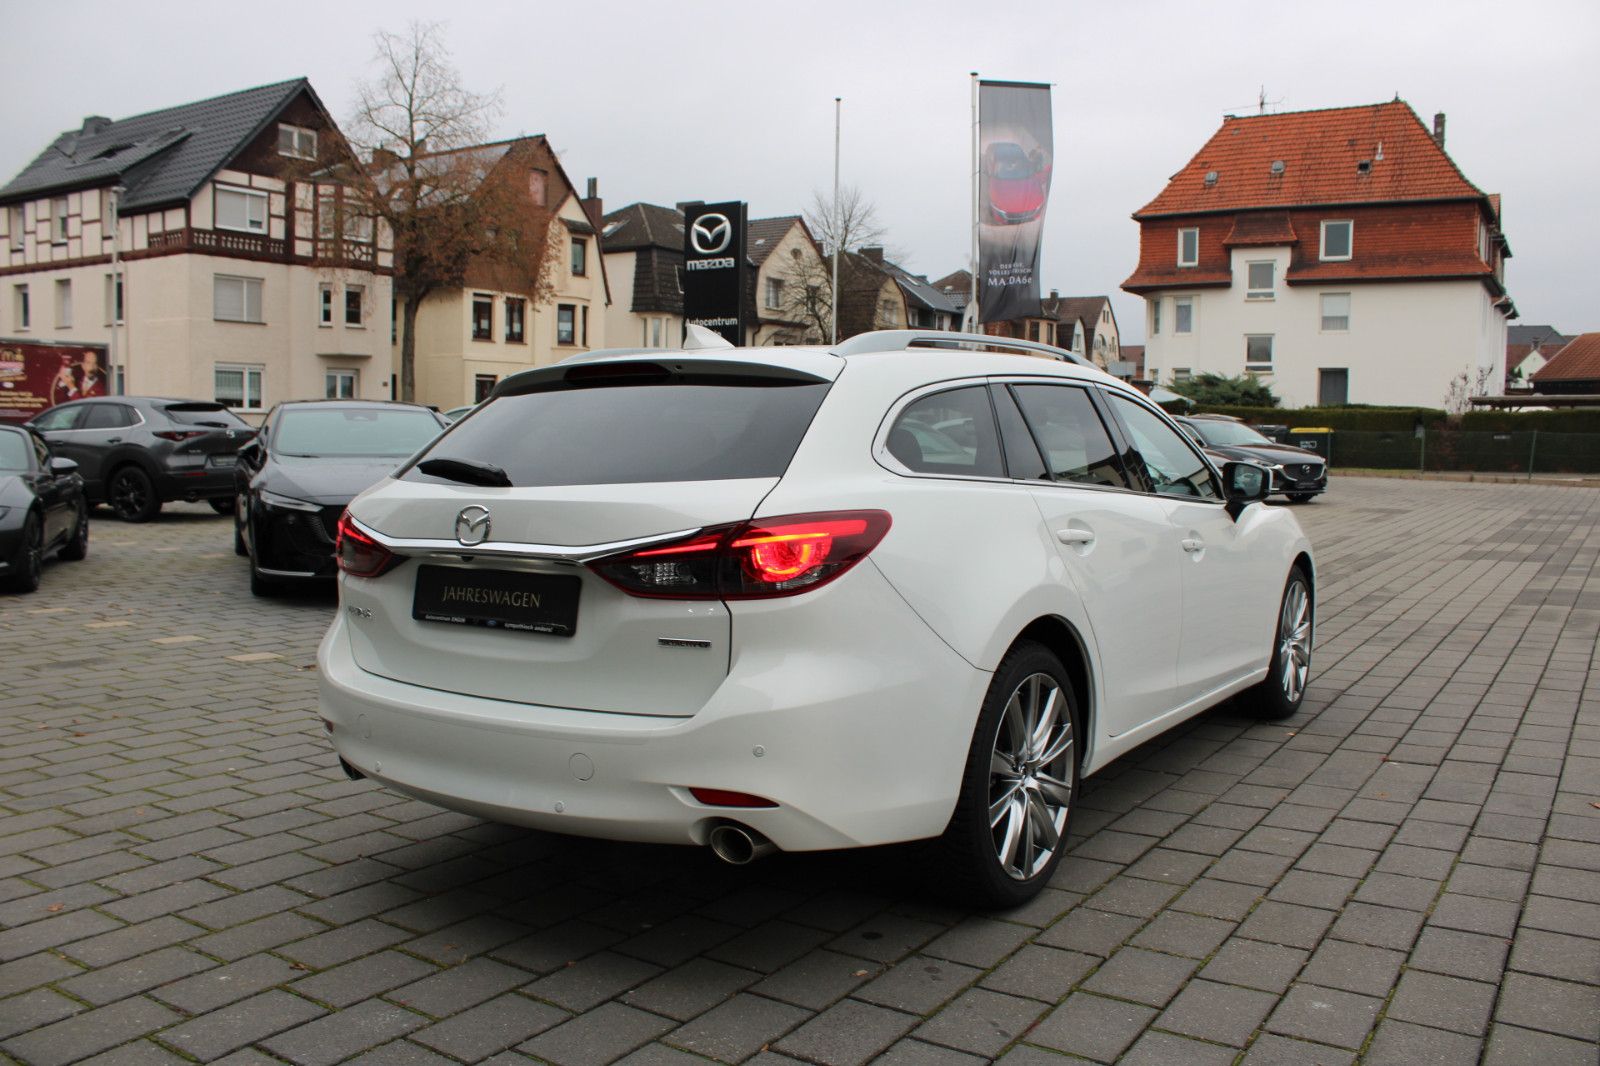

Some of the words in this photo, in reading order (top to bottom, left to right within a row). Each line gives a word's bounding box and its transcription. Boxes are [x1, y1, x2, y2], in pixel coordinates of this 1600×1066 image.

[687, 257, 735, 270] mazda
[988, 275, 1032, 286] MADA6e
[442, 586, 540, 608] JAHRESWAGEN
